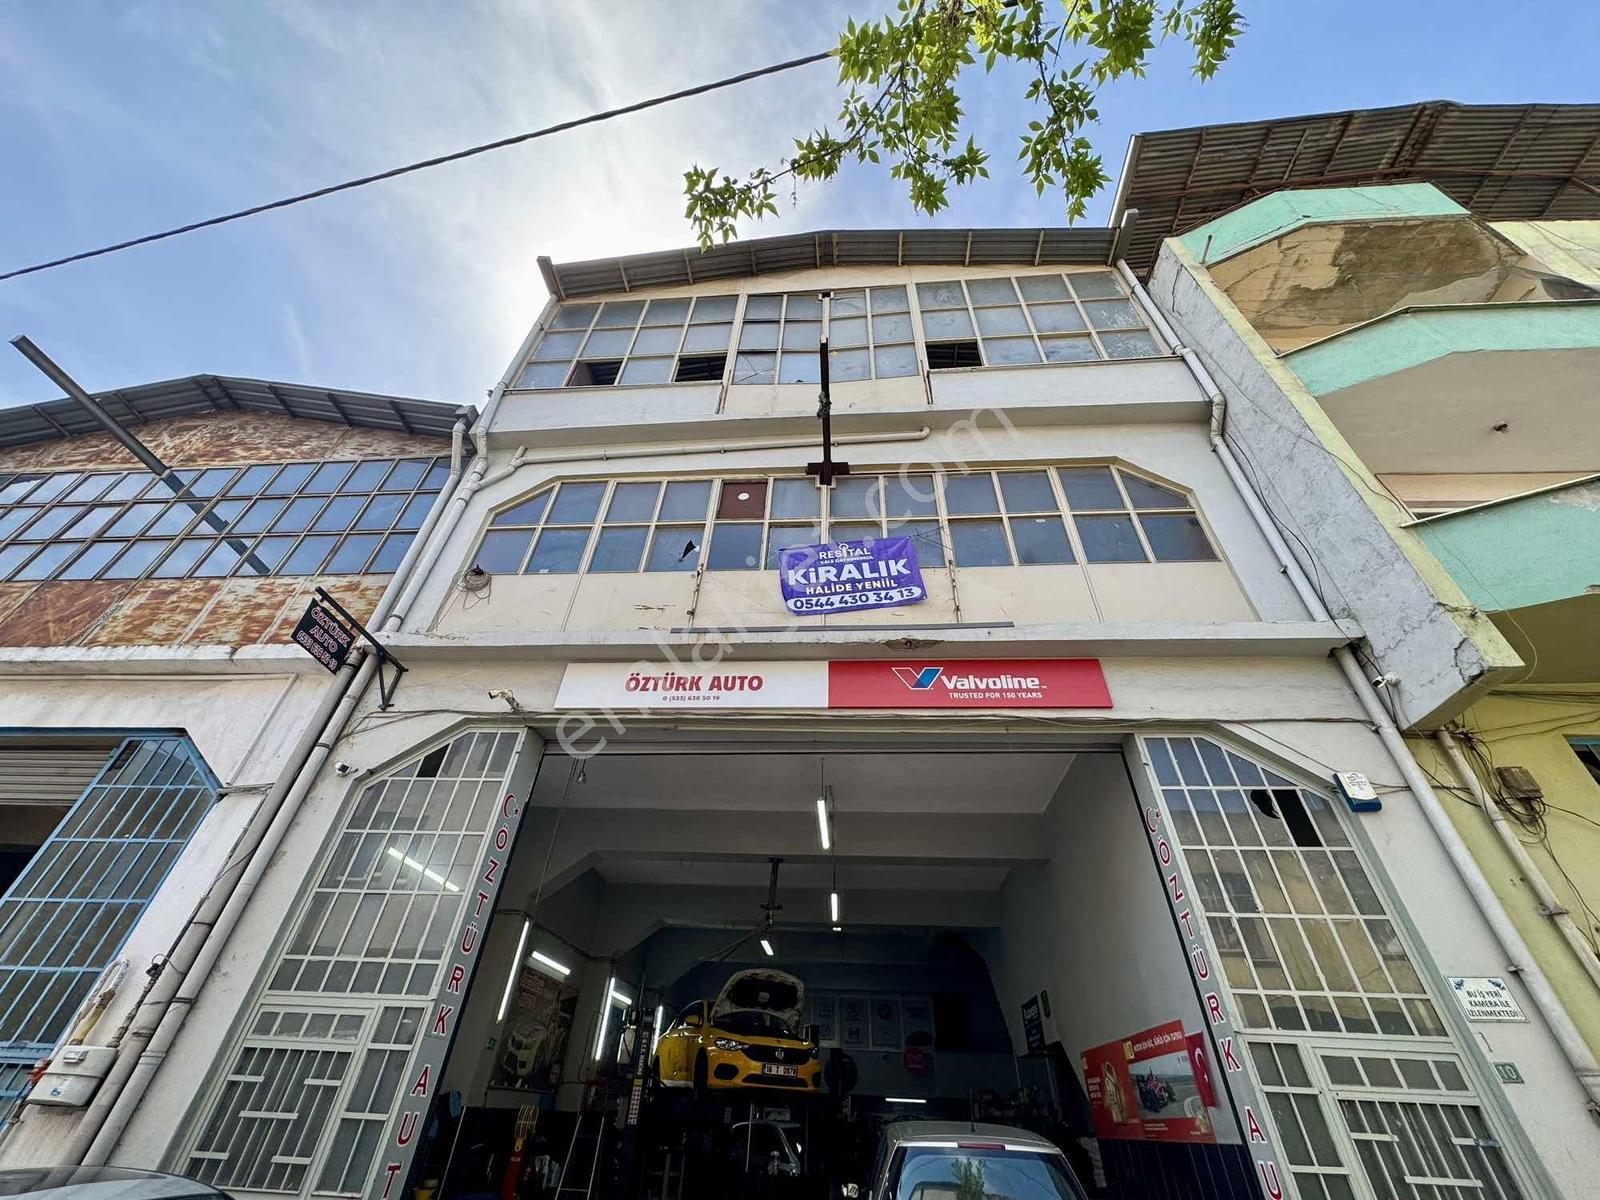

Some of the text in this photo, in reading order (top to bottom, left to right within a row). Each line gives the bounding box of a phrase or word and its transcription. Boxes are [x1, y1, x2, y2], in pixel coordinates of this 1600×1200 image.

[806, 581, 853, 595] HALİDE
[793, 587, 915, 610] 0544 430 34 13
[310, 625, 338, 652] AUTO
[625, 672, 763, 692] ÖZTÜRK AUTO
[940, 674, 1040, 690] Valvoline
[433, 824, 509, 1035] ÖZTÜRK
[1157, 836, 1242, 1072] ÖZTÜRK
[1466, 990, 1477, 998] BU
[1485, 989, 1503, 998] YERİ
[1468, 999, 1511, 1008] KAMERA İLE
